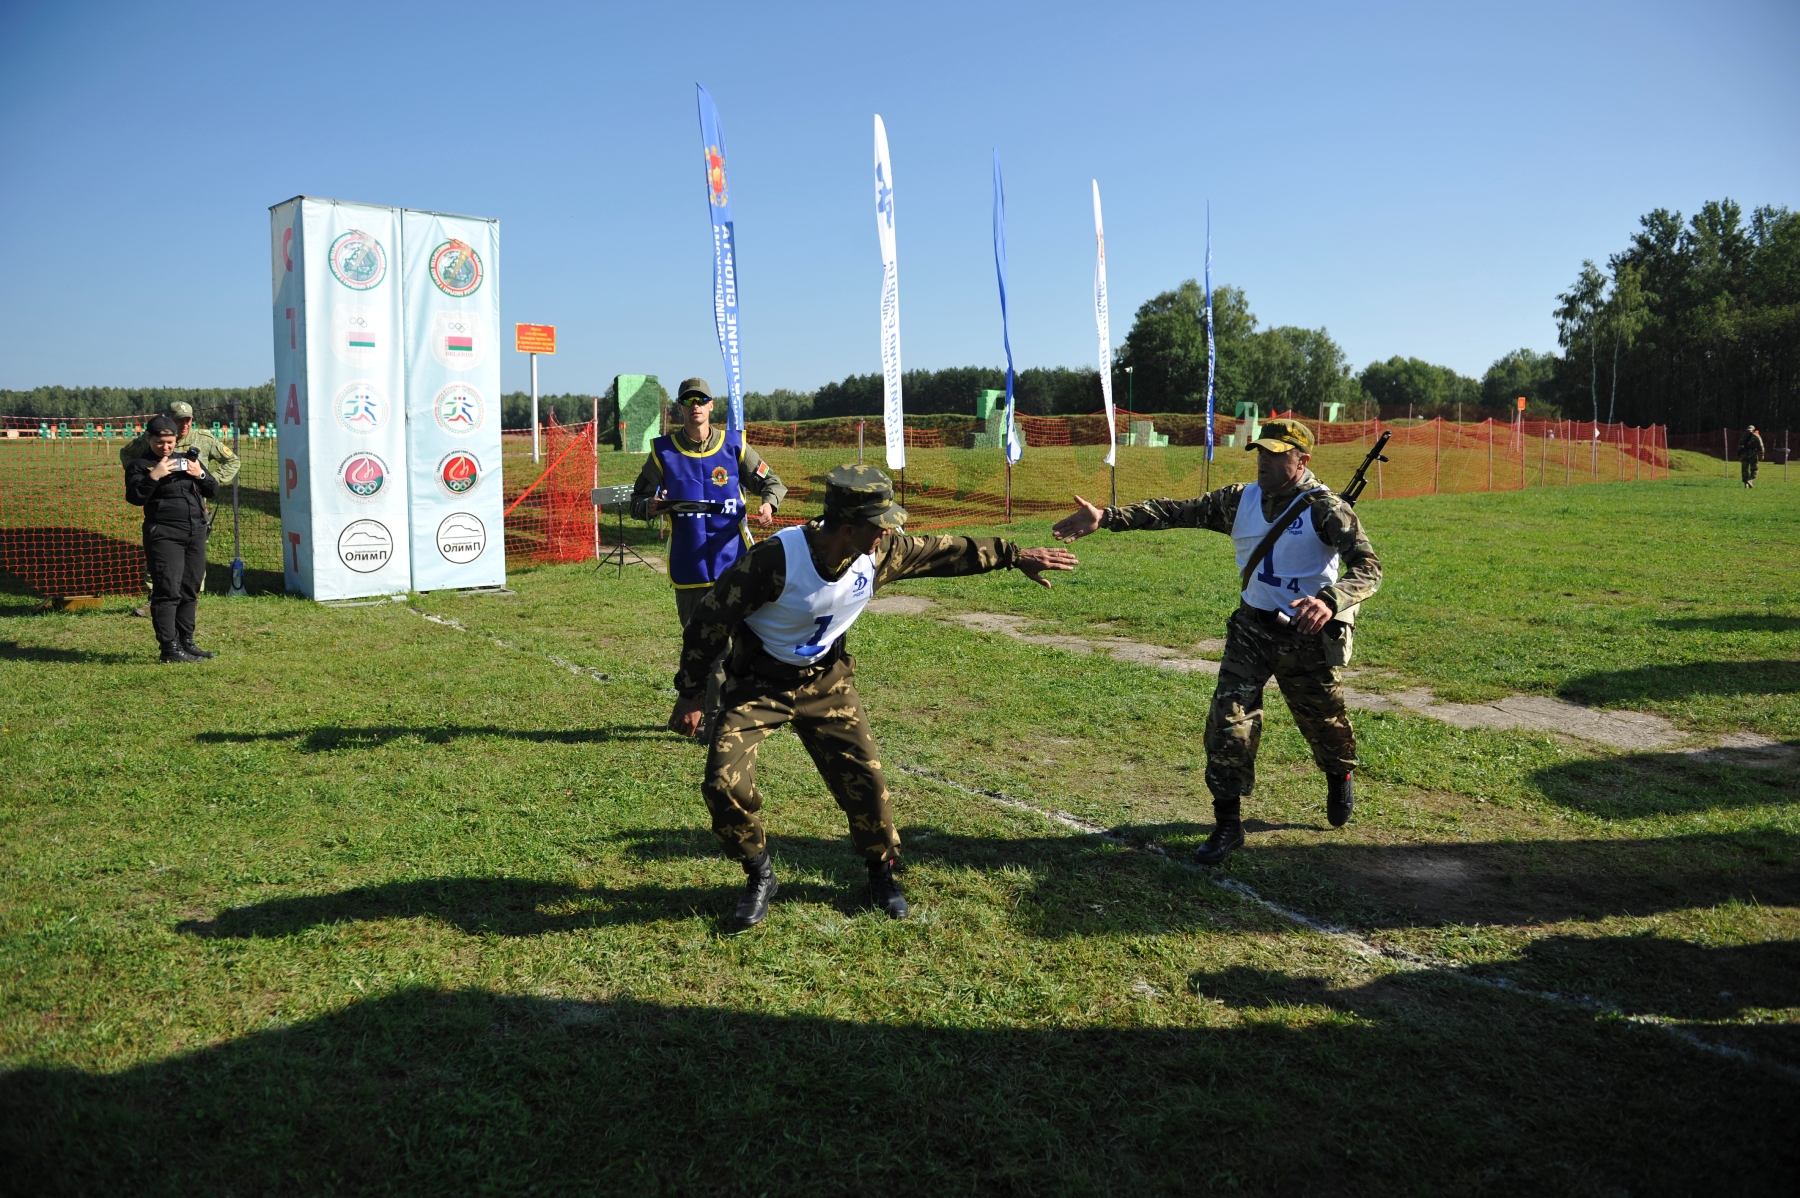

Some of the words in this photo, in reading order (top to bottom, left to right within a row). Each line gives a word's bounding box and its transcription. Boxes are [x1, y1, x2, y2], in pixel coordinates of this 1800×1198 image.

[282, 227, 301, 574] СТАРТ
[1286, 578, 1300, 593] 4
[794, 615, 834, 656] 1
